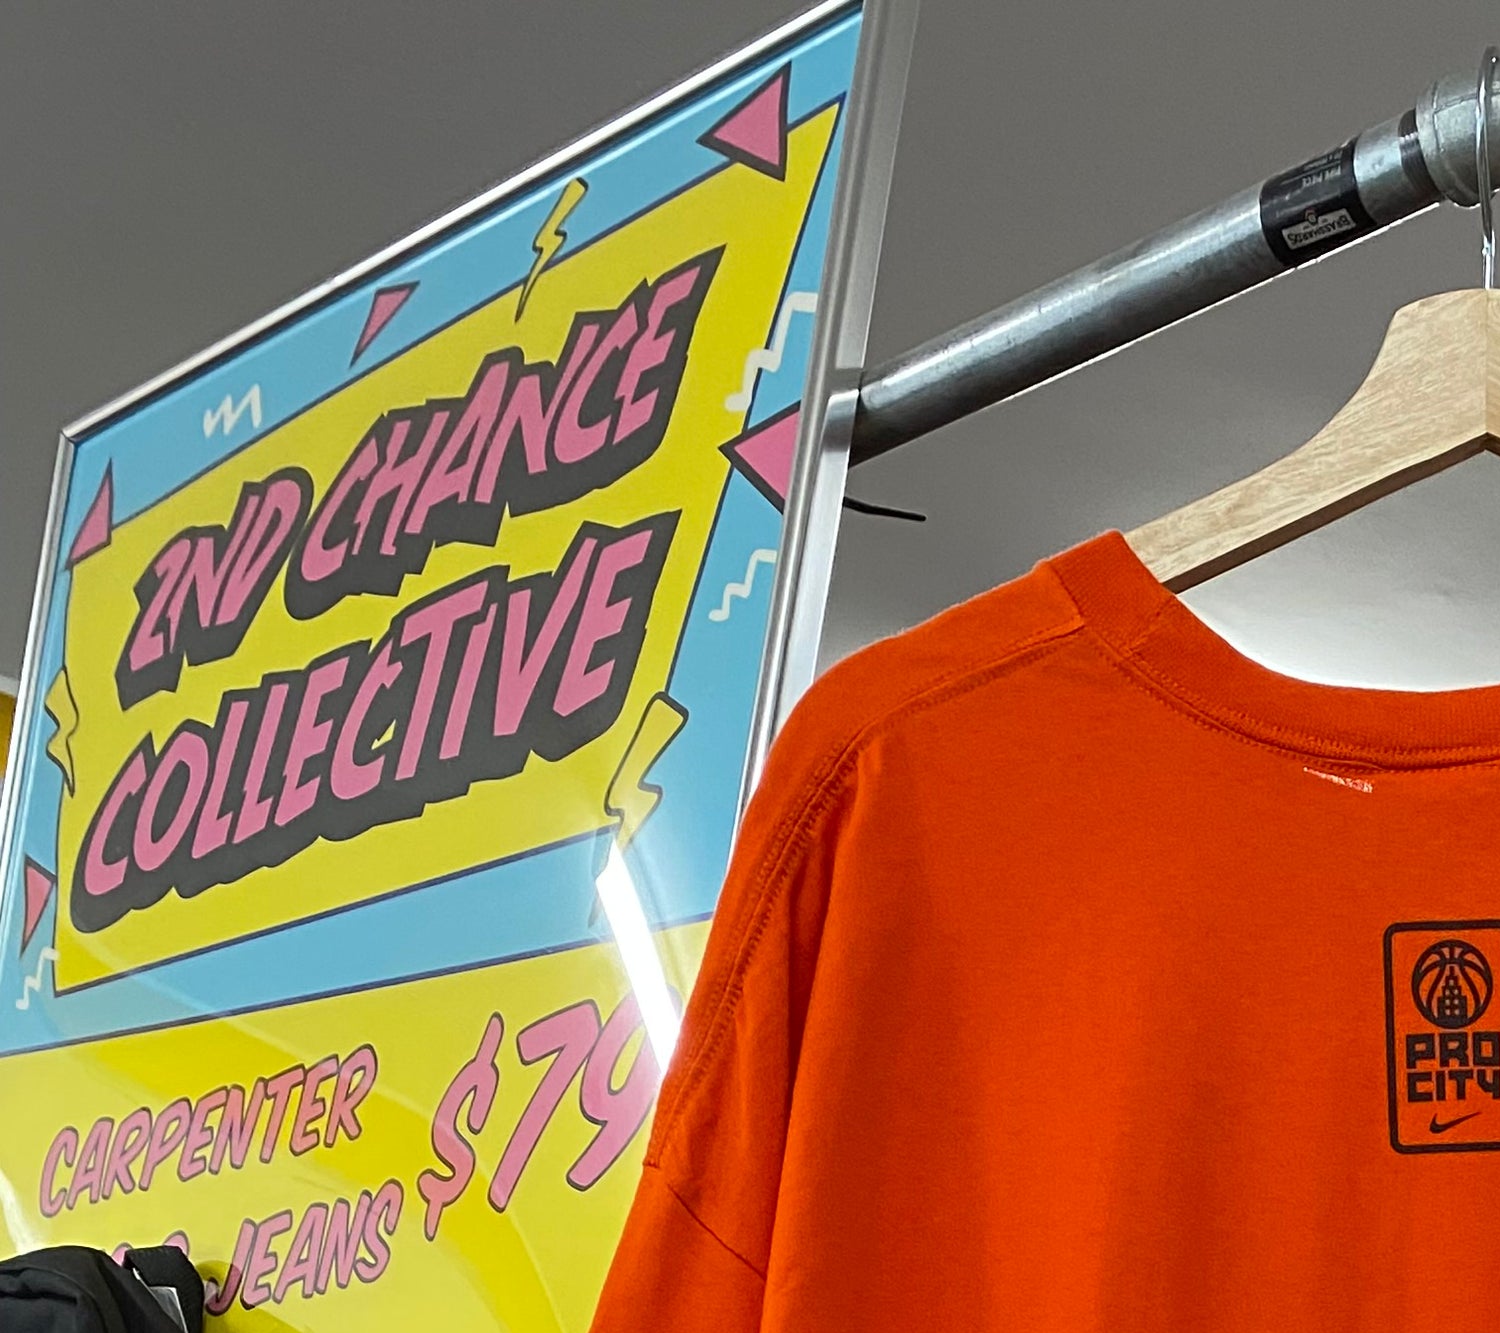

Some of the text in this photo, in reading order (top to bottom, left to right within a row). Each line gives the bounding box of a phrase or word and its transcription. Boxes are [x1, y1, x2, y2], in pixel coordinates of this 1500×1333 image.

[118, 250, 722, 705] 2ND CHANCE
[73, 515, 675, 928] COLLECTIVE
[38, 1043, 378, 1218] CARPENTER
[417, 983, 682, 1242] $79
[204, 1180, 405, 1316] JEANS
